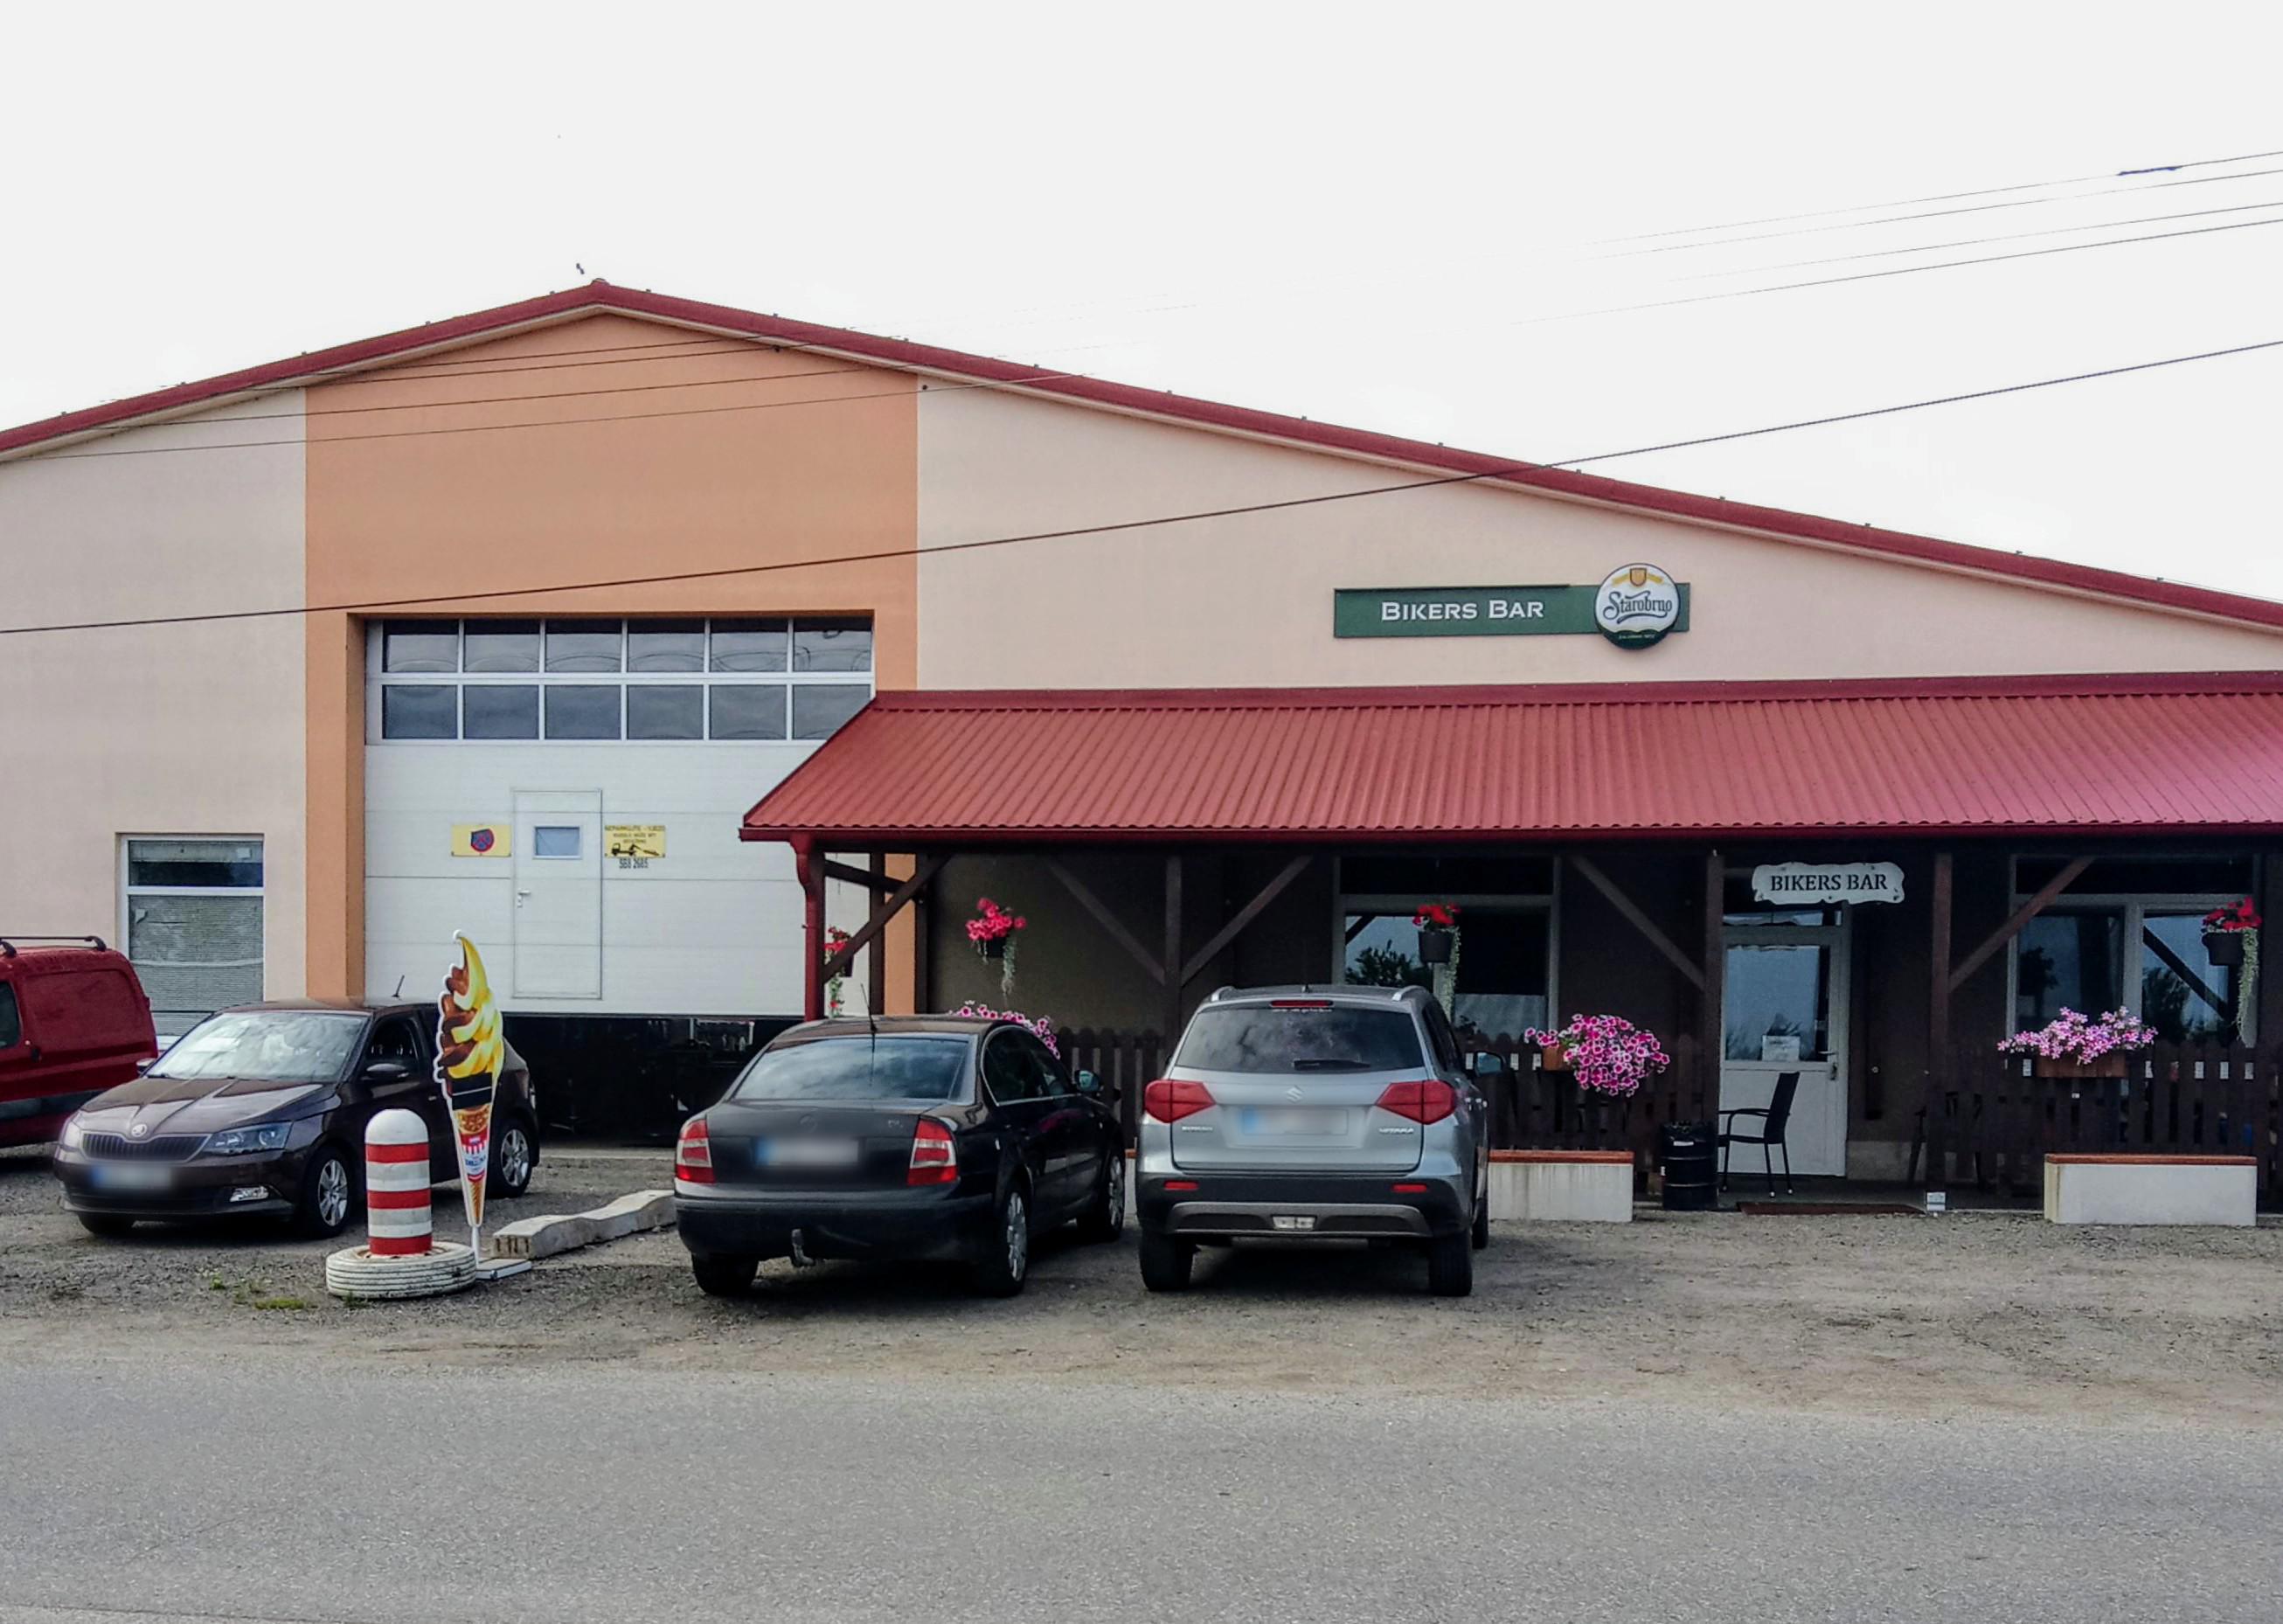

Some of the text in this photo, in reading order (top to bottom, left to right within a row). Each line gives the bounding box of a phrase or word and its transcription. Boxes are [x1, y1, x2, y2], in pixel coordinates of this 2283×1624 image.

[1381, 600, 1544, 621] BIKERS BAR
[1771, 874, 1888, 892] BIKERS BAR
